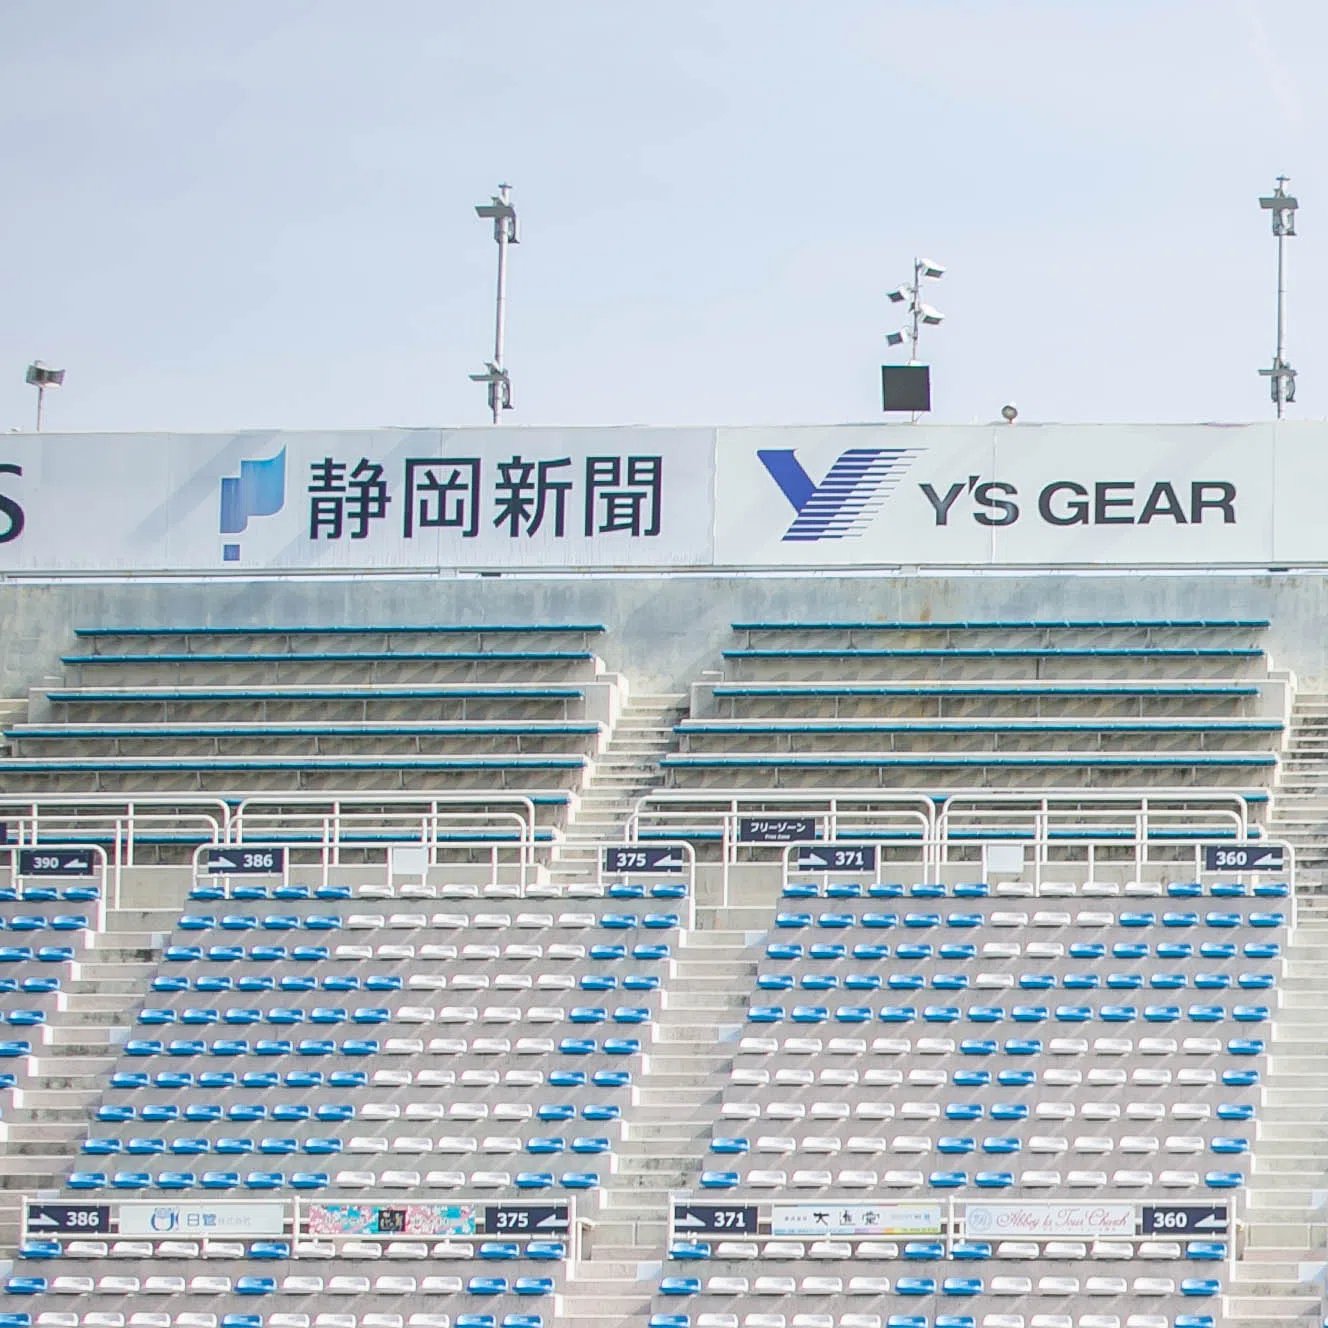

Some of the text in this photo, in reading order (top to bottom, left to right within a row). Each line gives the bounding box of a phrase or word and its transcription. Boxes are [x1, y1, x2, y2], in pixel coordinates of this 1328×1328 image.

[308, 456, 662, 539] 静岡新聞
[1039, 481, 1236, 525] GEAR
[751, 822, 805, 832] フリーゾーン
[34, 857, 58, 868] 390
[243, 854, 273, 868] 386
[616, 853, 646, 867] 375
[835, 851, 864, 866] 371
[1215, 851, 1247, 866] 360
[66, 1212, 99, 1226] 386
[497, 1213, 528, 1227] 375
[714, 1212, 745, 1227] 371
[1154, 1212, 1187, 1227] 360
